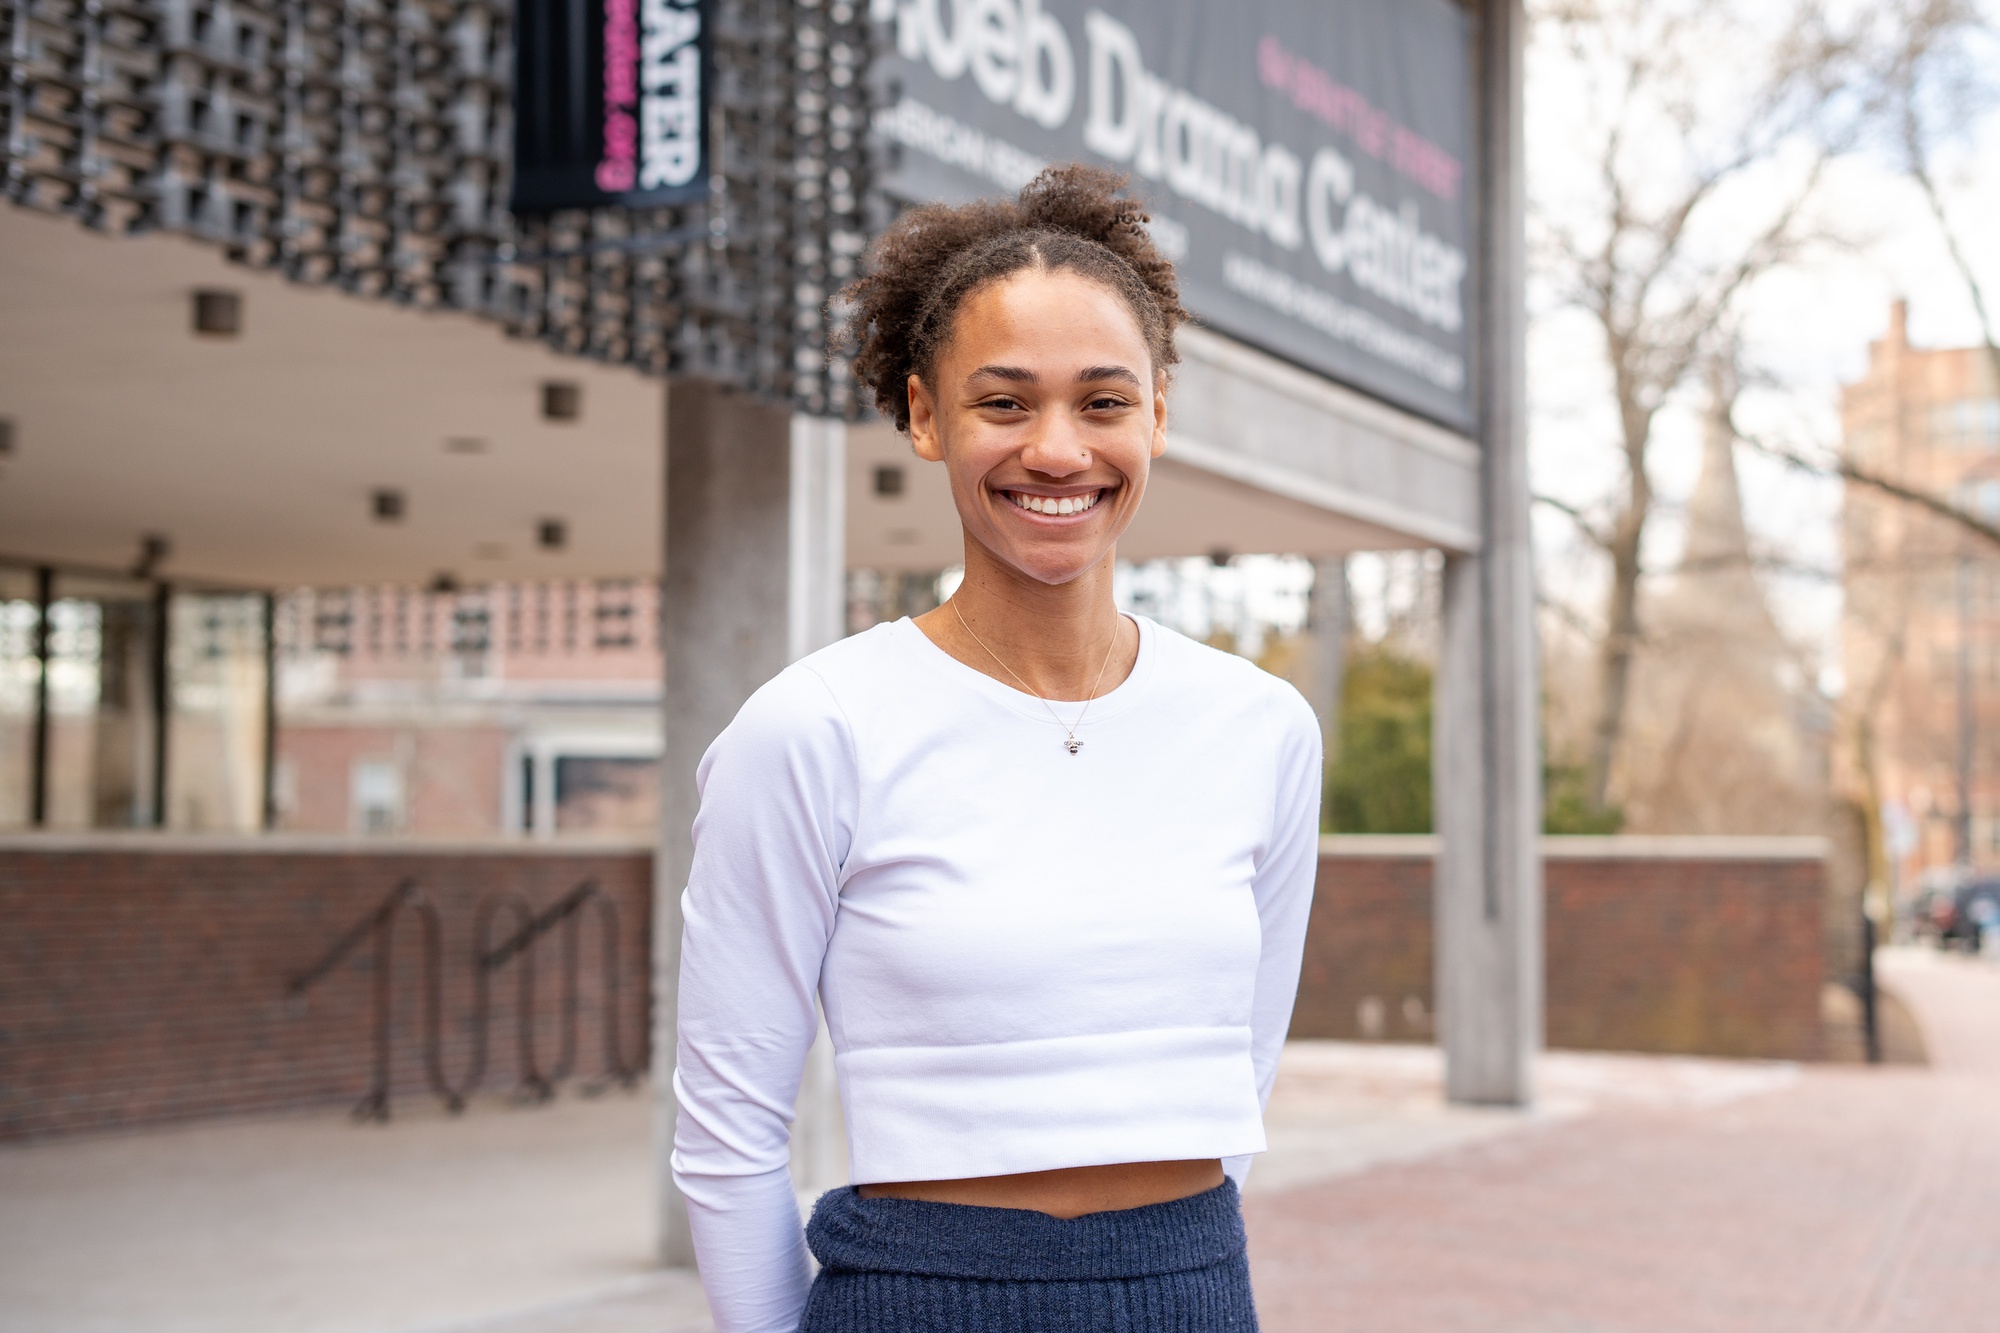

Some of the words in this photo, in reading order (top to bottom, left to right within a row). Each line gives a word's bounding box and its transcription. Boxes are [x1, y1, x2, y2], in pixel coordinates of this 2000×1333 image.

[639, 0, 701, 191] ATER
[1083, 12, 1301, 250] Drama
[1306, 146, 1467, 332] Center
